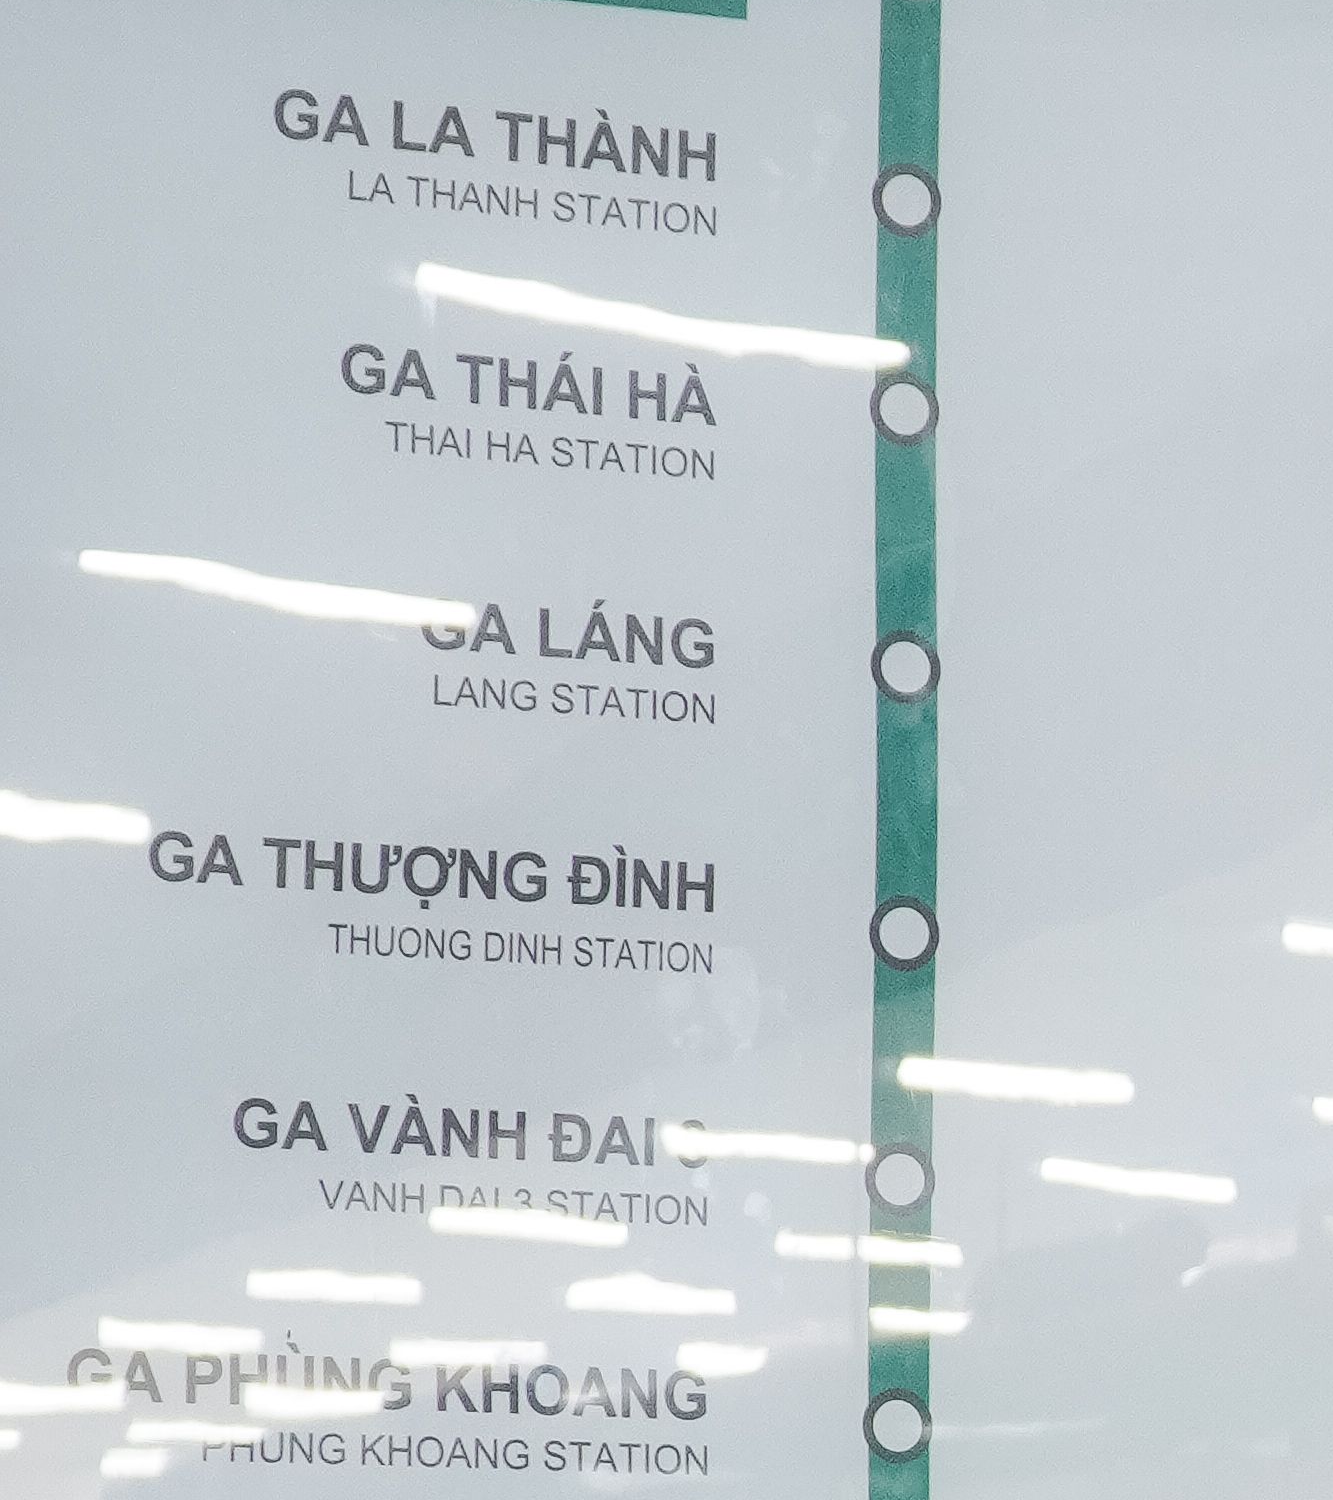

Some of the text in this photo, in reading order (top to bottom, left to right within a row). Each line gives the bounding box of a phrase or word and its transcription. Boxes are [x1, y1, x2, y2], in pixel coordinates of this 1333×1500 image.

[275, 90, 716, 181] GA LA THÀNH
[349, 170, 716, 236] LA THANH STATION
[342, 344, 716, 426] GA THÁI HÀ
[385, 421, 714, 480] THAI HA STATION
[540, 599, 714, 668] LÁNG
[434, 675, 714, 724] LANG STATION
[150, 831, 714, 912] GA THƯỢNG ĐÌNH
[328, 924, 712, 973] THUONG DINH STATION
[234, 1098, 328, 1151] GA
[348, 1094, 526, 1160] VÀNH
[548, 1113, 654, 1166] ĐAI
[319, 1179, 424, 1213] VANH
[548, 1190, 707, 1226] STATION
[67, 1348, 163, 1402] GA
[437, 1365, 706, 1420] KHOANG
[204, 1432, 707, 1475] PHUNG KHOANG STATION
